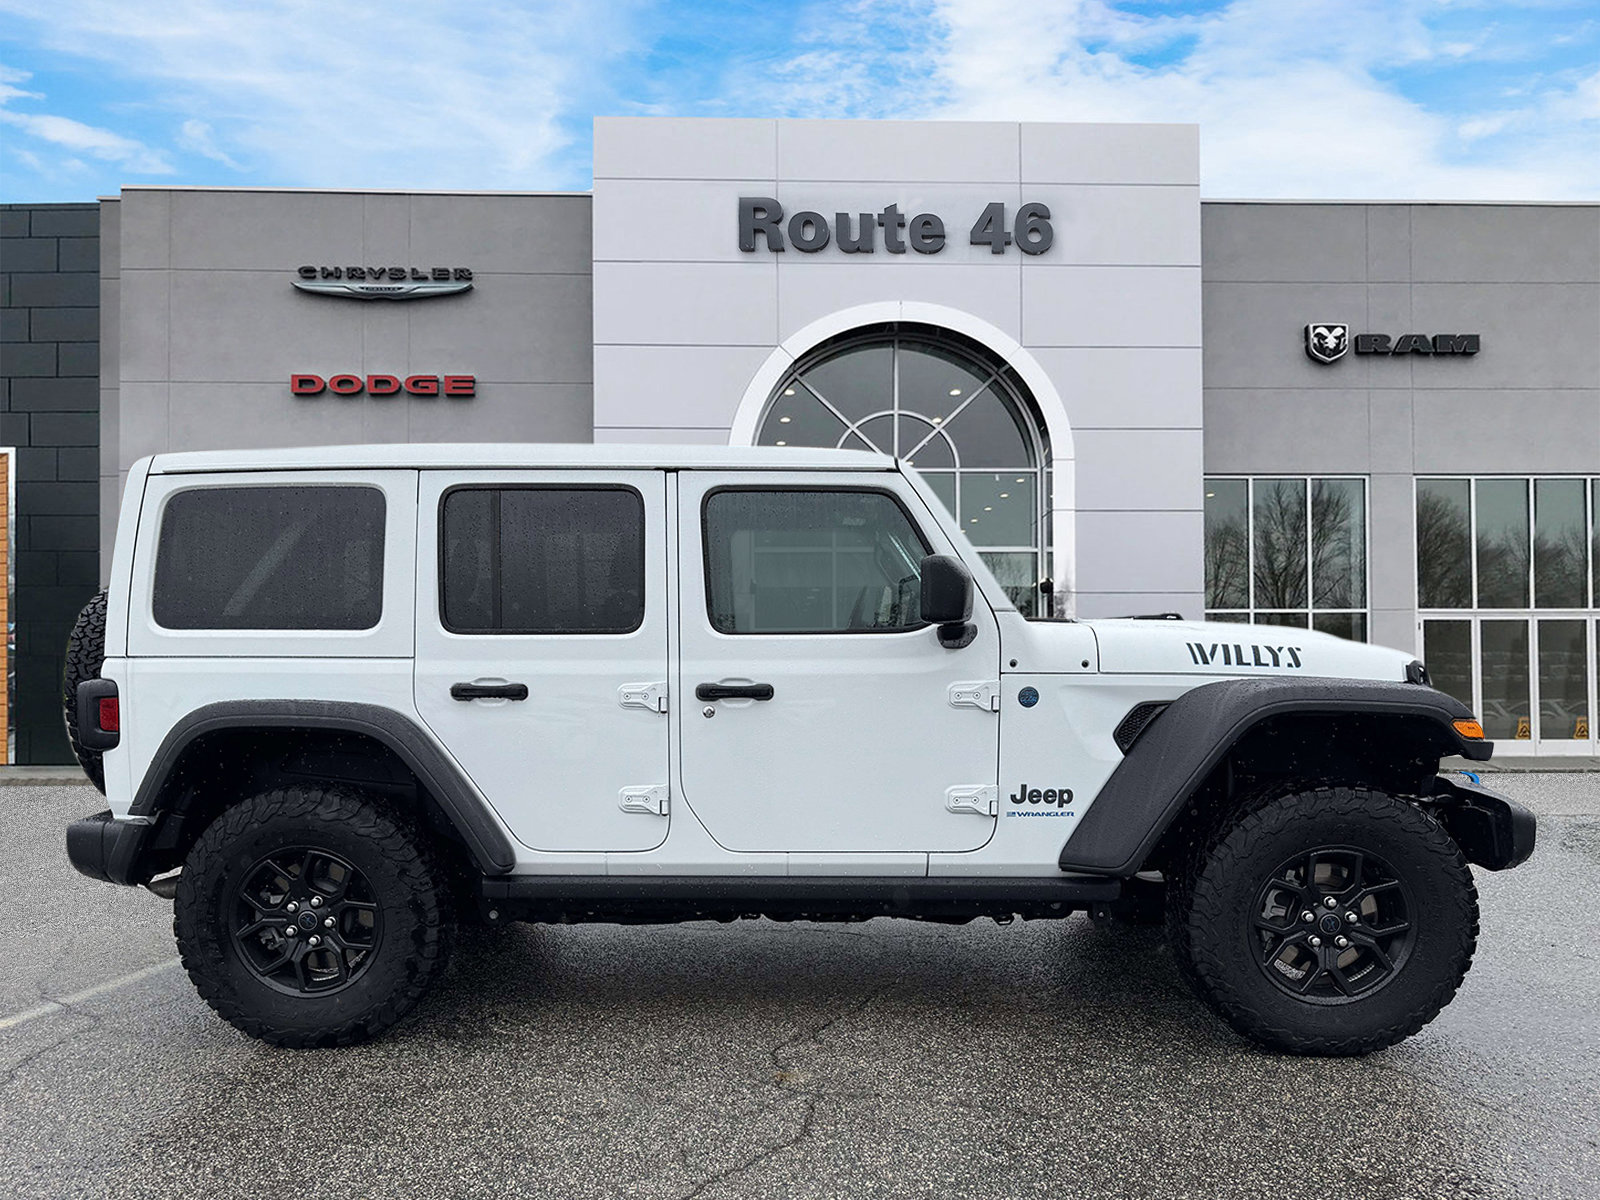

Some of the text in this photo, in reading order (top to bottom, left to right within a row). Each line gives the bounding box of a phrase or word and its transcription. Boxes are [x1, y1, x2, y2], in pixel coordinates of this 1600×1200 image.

[738, 196, 1054, 255] Route 46
[298, 265, 473, 281] CHRYSLER
[1354, 333, 1481, 356] RAM
[291, 373, 476, 397] DODGE
[1185, 642, 1302, 668] WILLYS
[1010, 783, 1074, 809] Jeep
